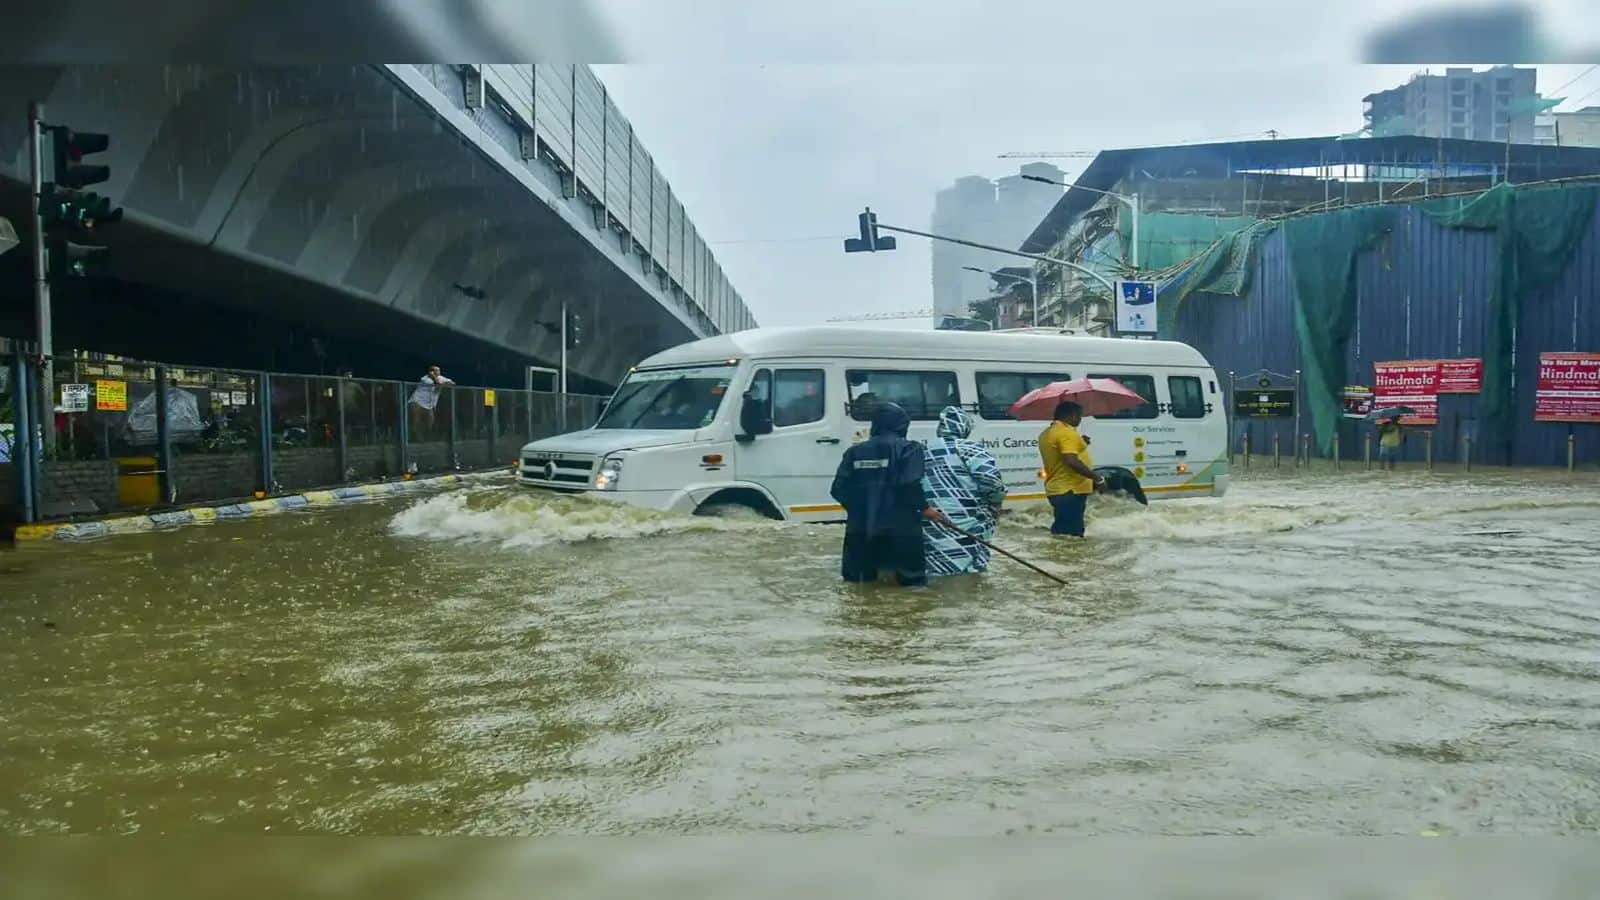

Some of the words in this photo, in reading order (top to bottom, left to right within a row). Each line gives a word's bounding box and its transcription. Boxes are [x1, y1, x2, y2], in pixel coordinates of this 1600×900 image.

[1375, 374, 1434, 386] Hindmata
[1147, 425, 1176, 433] Services
[981, 437, 1000, 448] hvi
[1003, 437, 1039, 448] Cance
